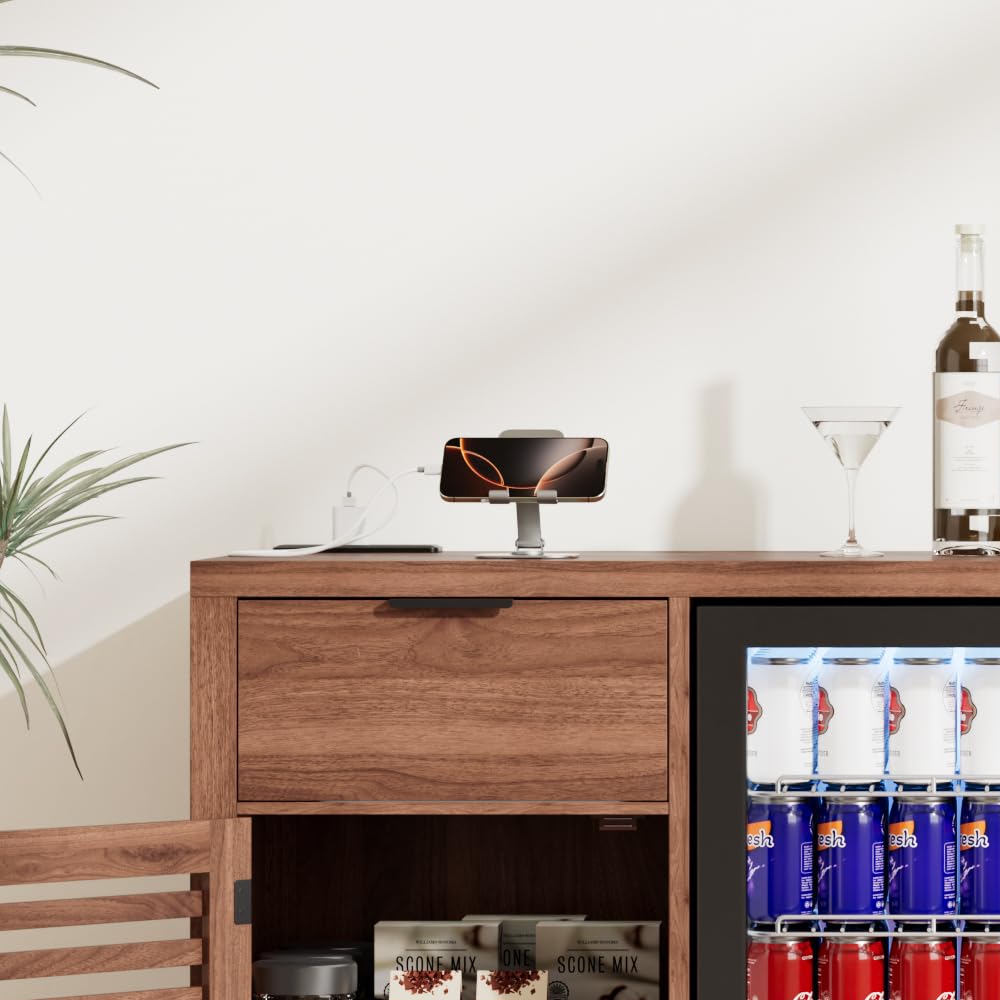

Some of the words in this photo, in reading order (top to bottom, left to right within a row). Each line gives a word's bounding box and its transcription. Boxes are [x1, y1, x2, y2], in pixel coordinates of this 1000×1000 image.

[747, 829, 774, 848] esh
[818, 829, 846, 848] esh
[888, 829, 917, 848] esh
[959, 829, 989, 848] esh
[396, 955, 443, 972] SCONE
[451, 956, 476, 973] MIX
[503, 949, 530, 967] ONE
[557, 955, 605, 974] SCONE
[612, 955, 638, 974] MIX
